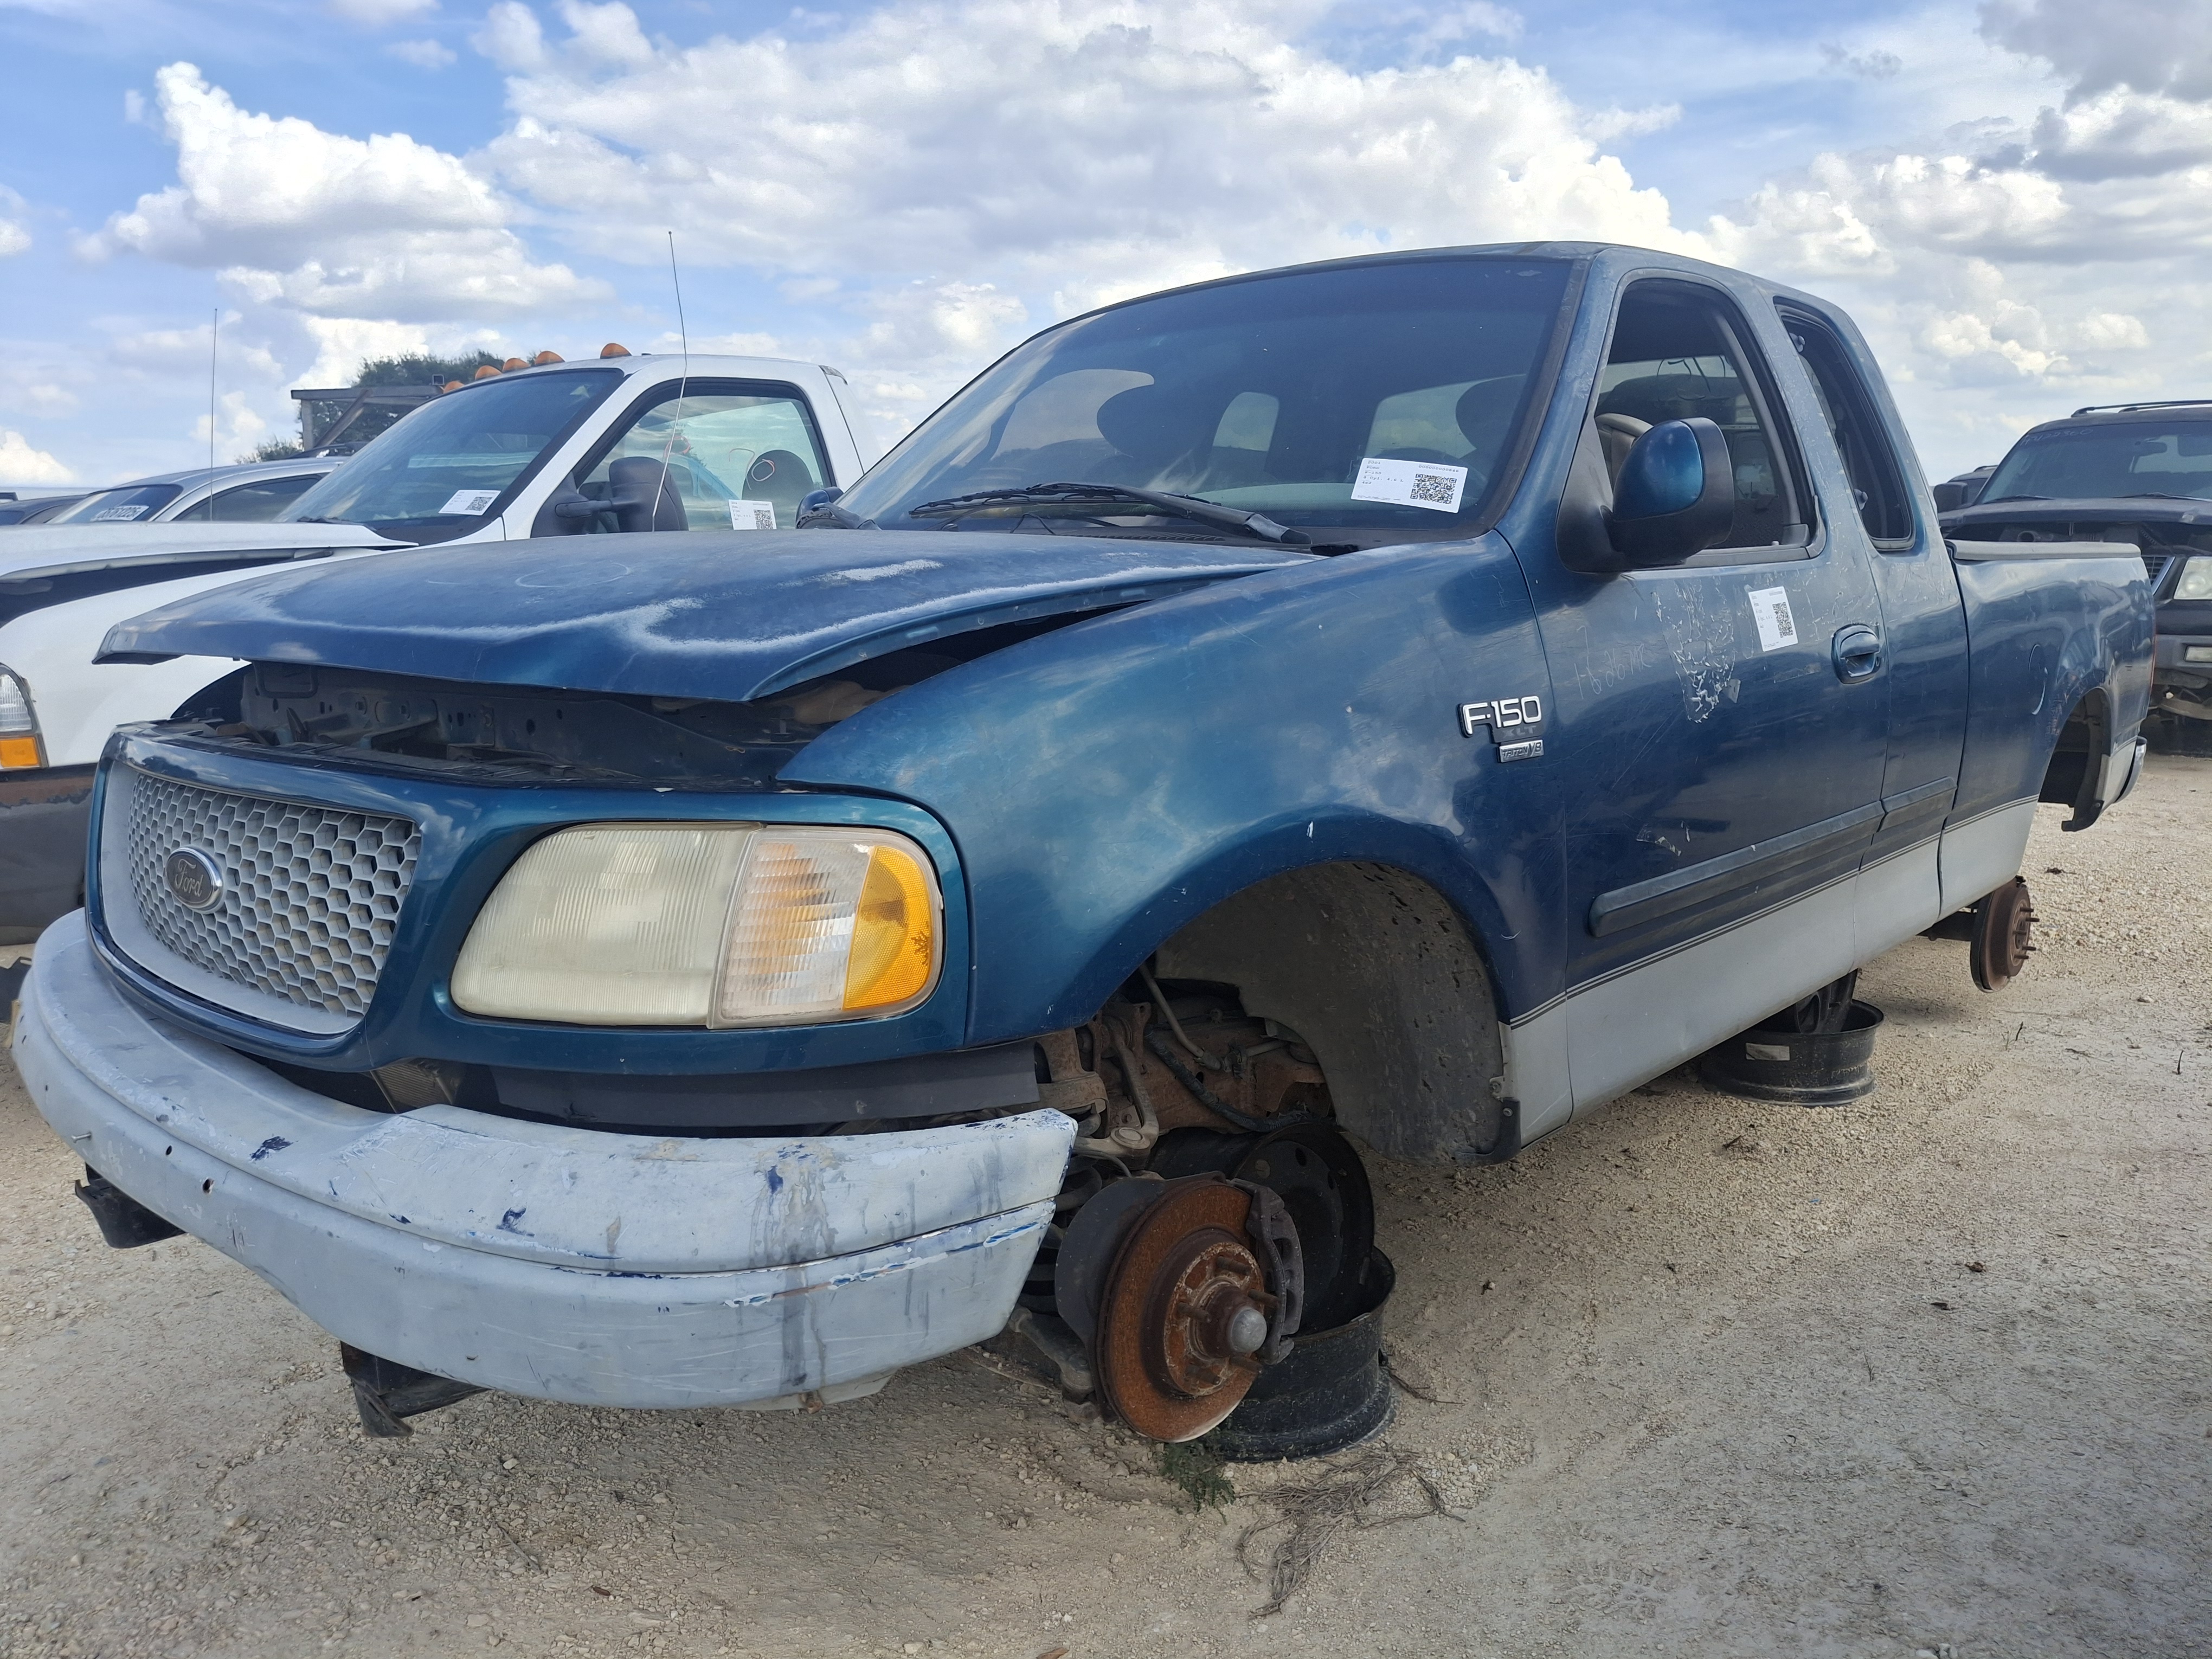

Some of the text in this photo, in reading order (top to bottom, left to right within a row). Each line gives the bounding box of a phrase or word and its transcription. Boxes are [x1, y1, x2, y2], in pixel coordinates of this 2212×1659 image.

[1501, 725, 1537, 738] XLT
[1501, 741, 1542, 759] TRITON V8
[175, 858, 204, 898] Ford
